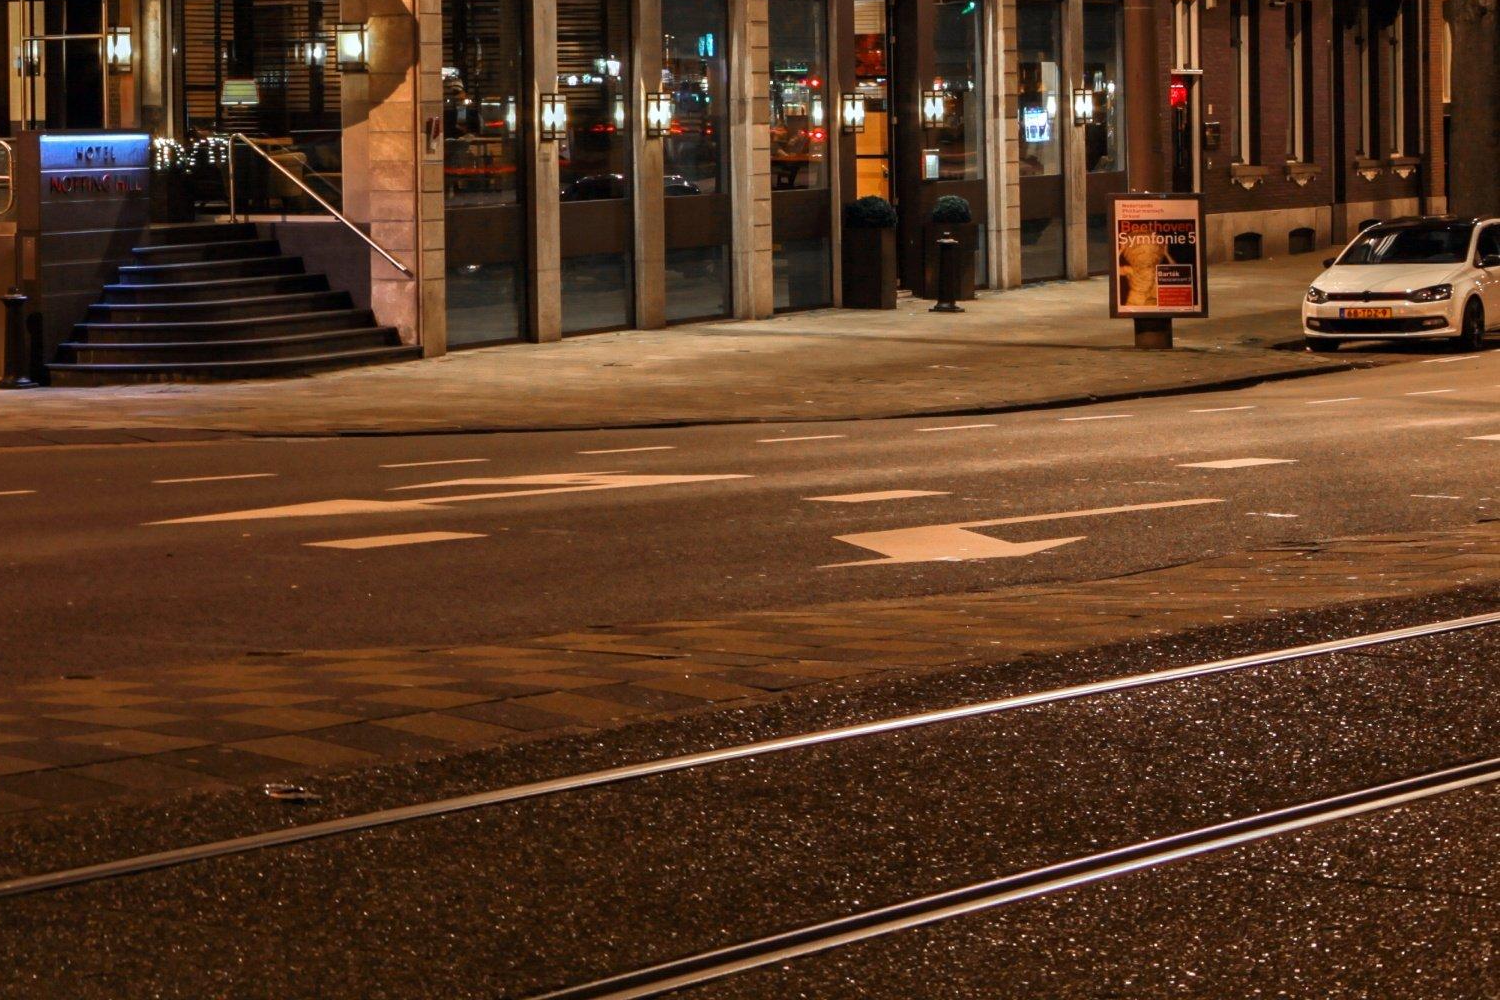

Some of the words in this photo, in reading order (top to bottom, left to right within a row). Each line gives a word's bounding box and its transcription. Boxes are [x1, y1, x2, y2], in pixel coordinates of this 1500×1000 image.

[76, 146, 116, 161] HOTEL
[51, 173, 112, 194] NOTTING
[115, 175, 143, 192] HILL
[1121, 221, 1193, 232] Beethoven
[1119, 232, 1186, 247] Symfonie
[1188, 232, 1197, 244] 5
